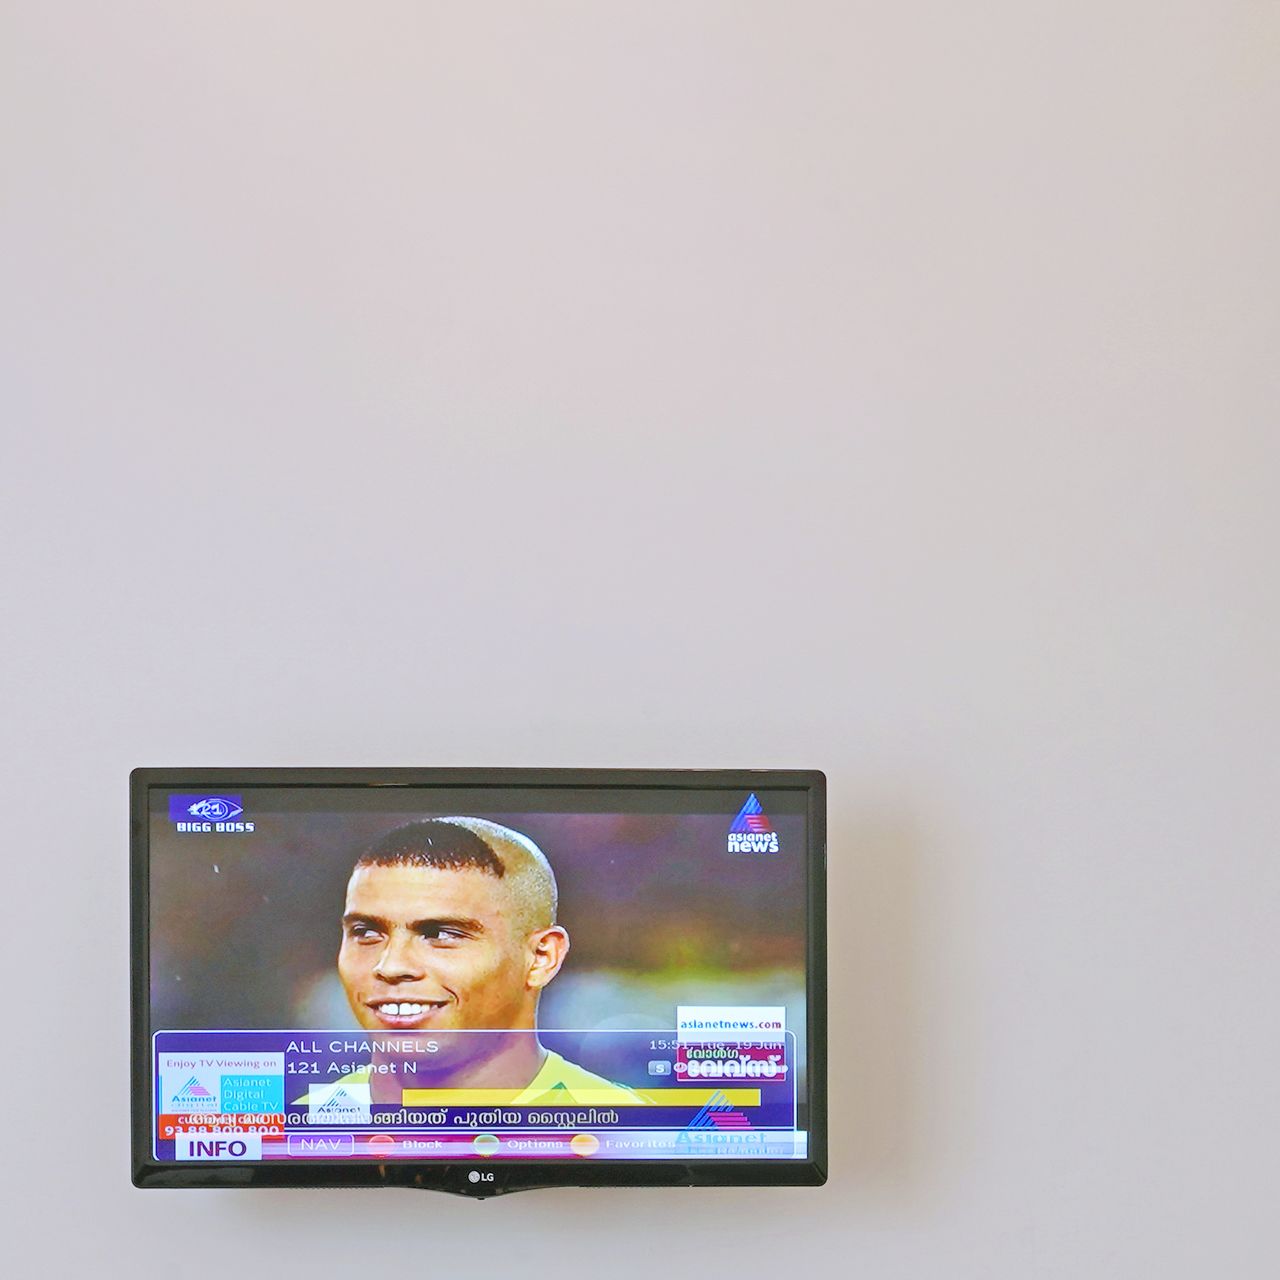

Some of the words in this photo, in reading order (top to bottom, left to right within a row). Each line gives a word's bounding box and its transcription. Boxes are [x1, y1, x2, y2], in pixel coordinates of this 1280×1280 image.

[176, 822, 212, 833] BIGG
[215, 822, 256, 833] BOSS
[727, 832, 778, 842] asianet
[727, 841, 780, 853] news
[680, 1019, 782, 1030] asianetnews.com
[286, 1041, 322, 1053] ALL
[329, 1041, 440, 1053] CHANNELS
[166, 1060, 197, 1069] Enjoy
[215, 1060, 261, 1069] Viewing
[287, 1062, 320, 1074] 121
[327, 1062, 397, 1074] Asianet
[403, 1062, 417, 1074] N
[223, 1078, 272, 1087] Asianet
[223, 1090, 265, 1101] Digital
[223, 1102, 260, 1112] Cable
[263, 1102, 280, 1111] TV
[453, 1108, 522, 1128] പുതിയ
[189, 1141, 247, 1157] INFO
[300, 1139, 342, 1150] NAV
[403, 1140, 443, 1149] Block
[507, 1140, 563, 1151] Options
[480, 1172, 495, 1182] LG
